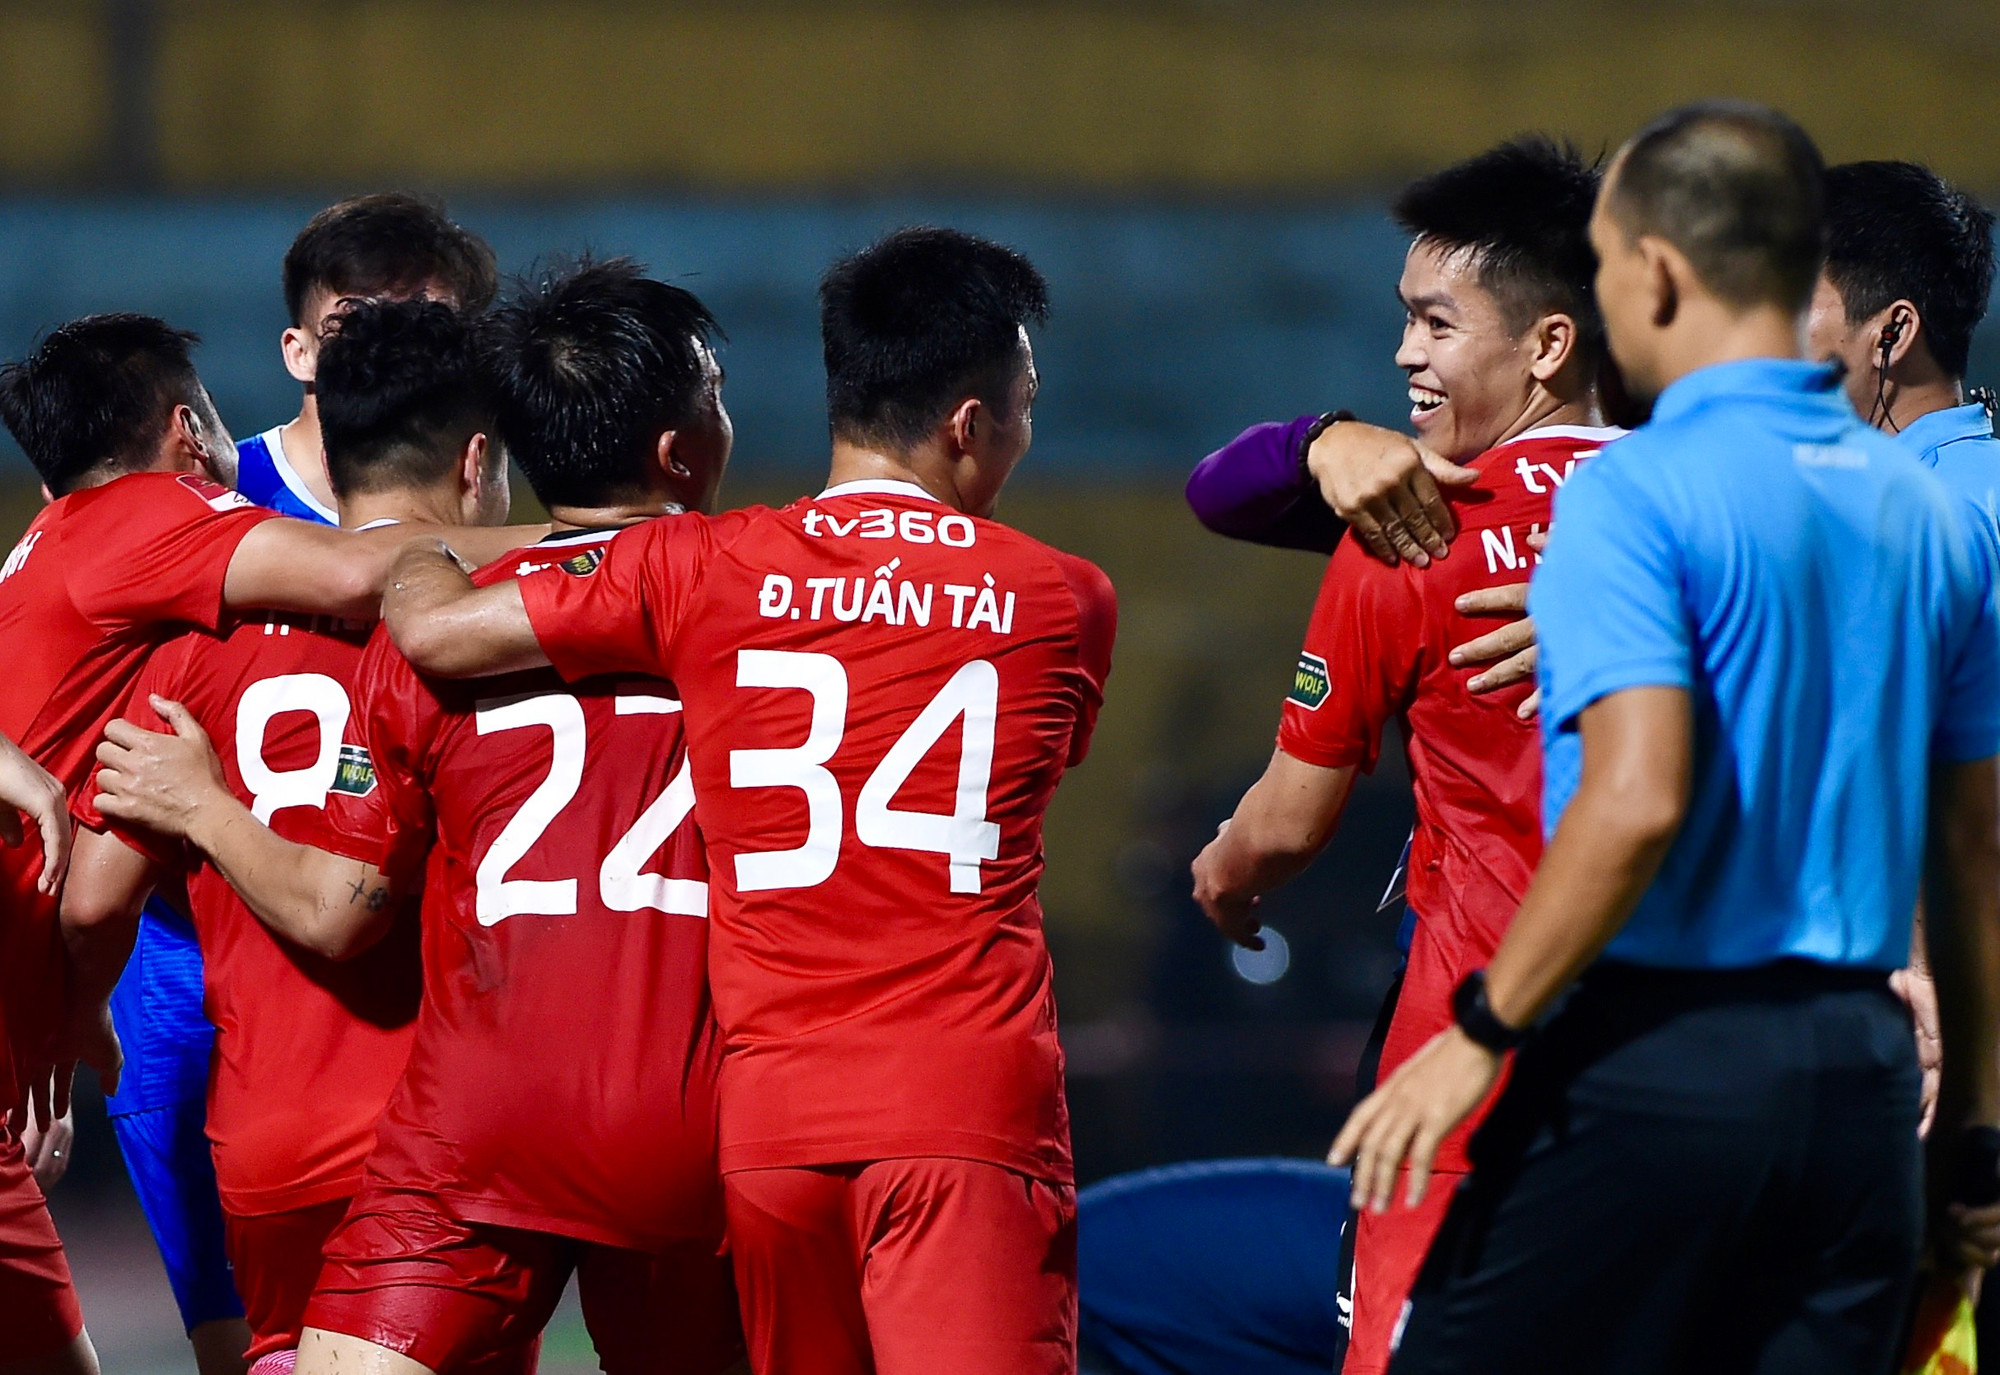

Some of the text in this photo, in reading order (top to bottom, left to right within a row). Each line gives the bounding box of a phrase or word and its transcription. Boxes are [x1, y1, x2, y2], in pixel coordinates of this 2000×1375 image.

[801, 508, 976, 548] tv360
[758, 556, 1016, 634] Đ.TUẤN TÀI
[1294, 670, 1325, 696] WOLF
[235, 672, 351, 828] 8
[342, 763, 374, 784] WOLF
[730, 649, 1001, 894] 34
[475, 693, 709, 927] 22
